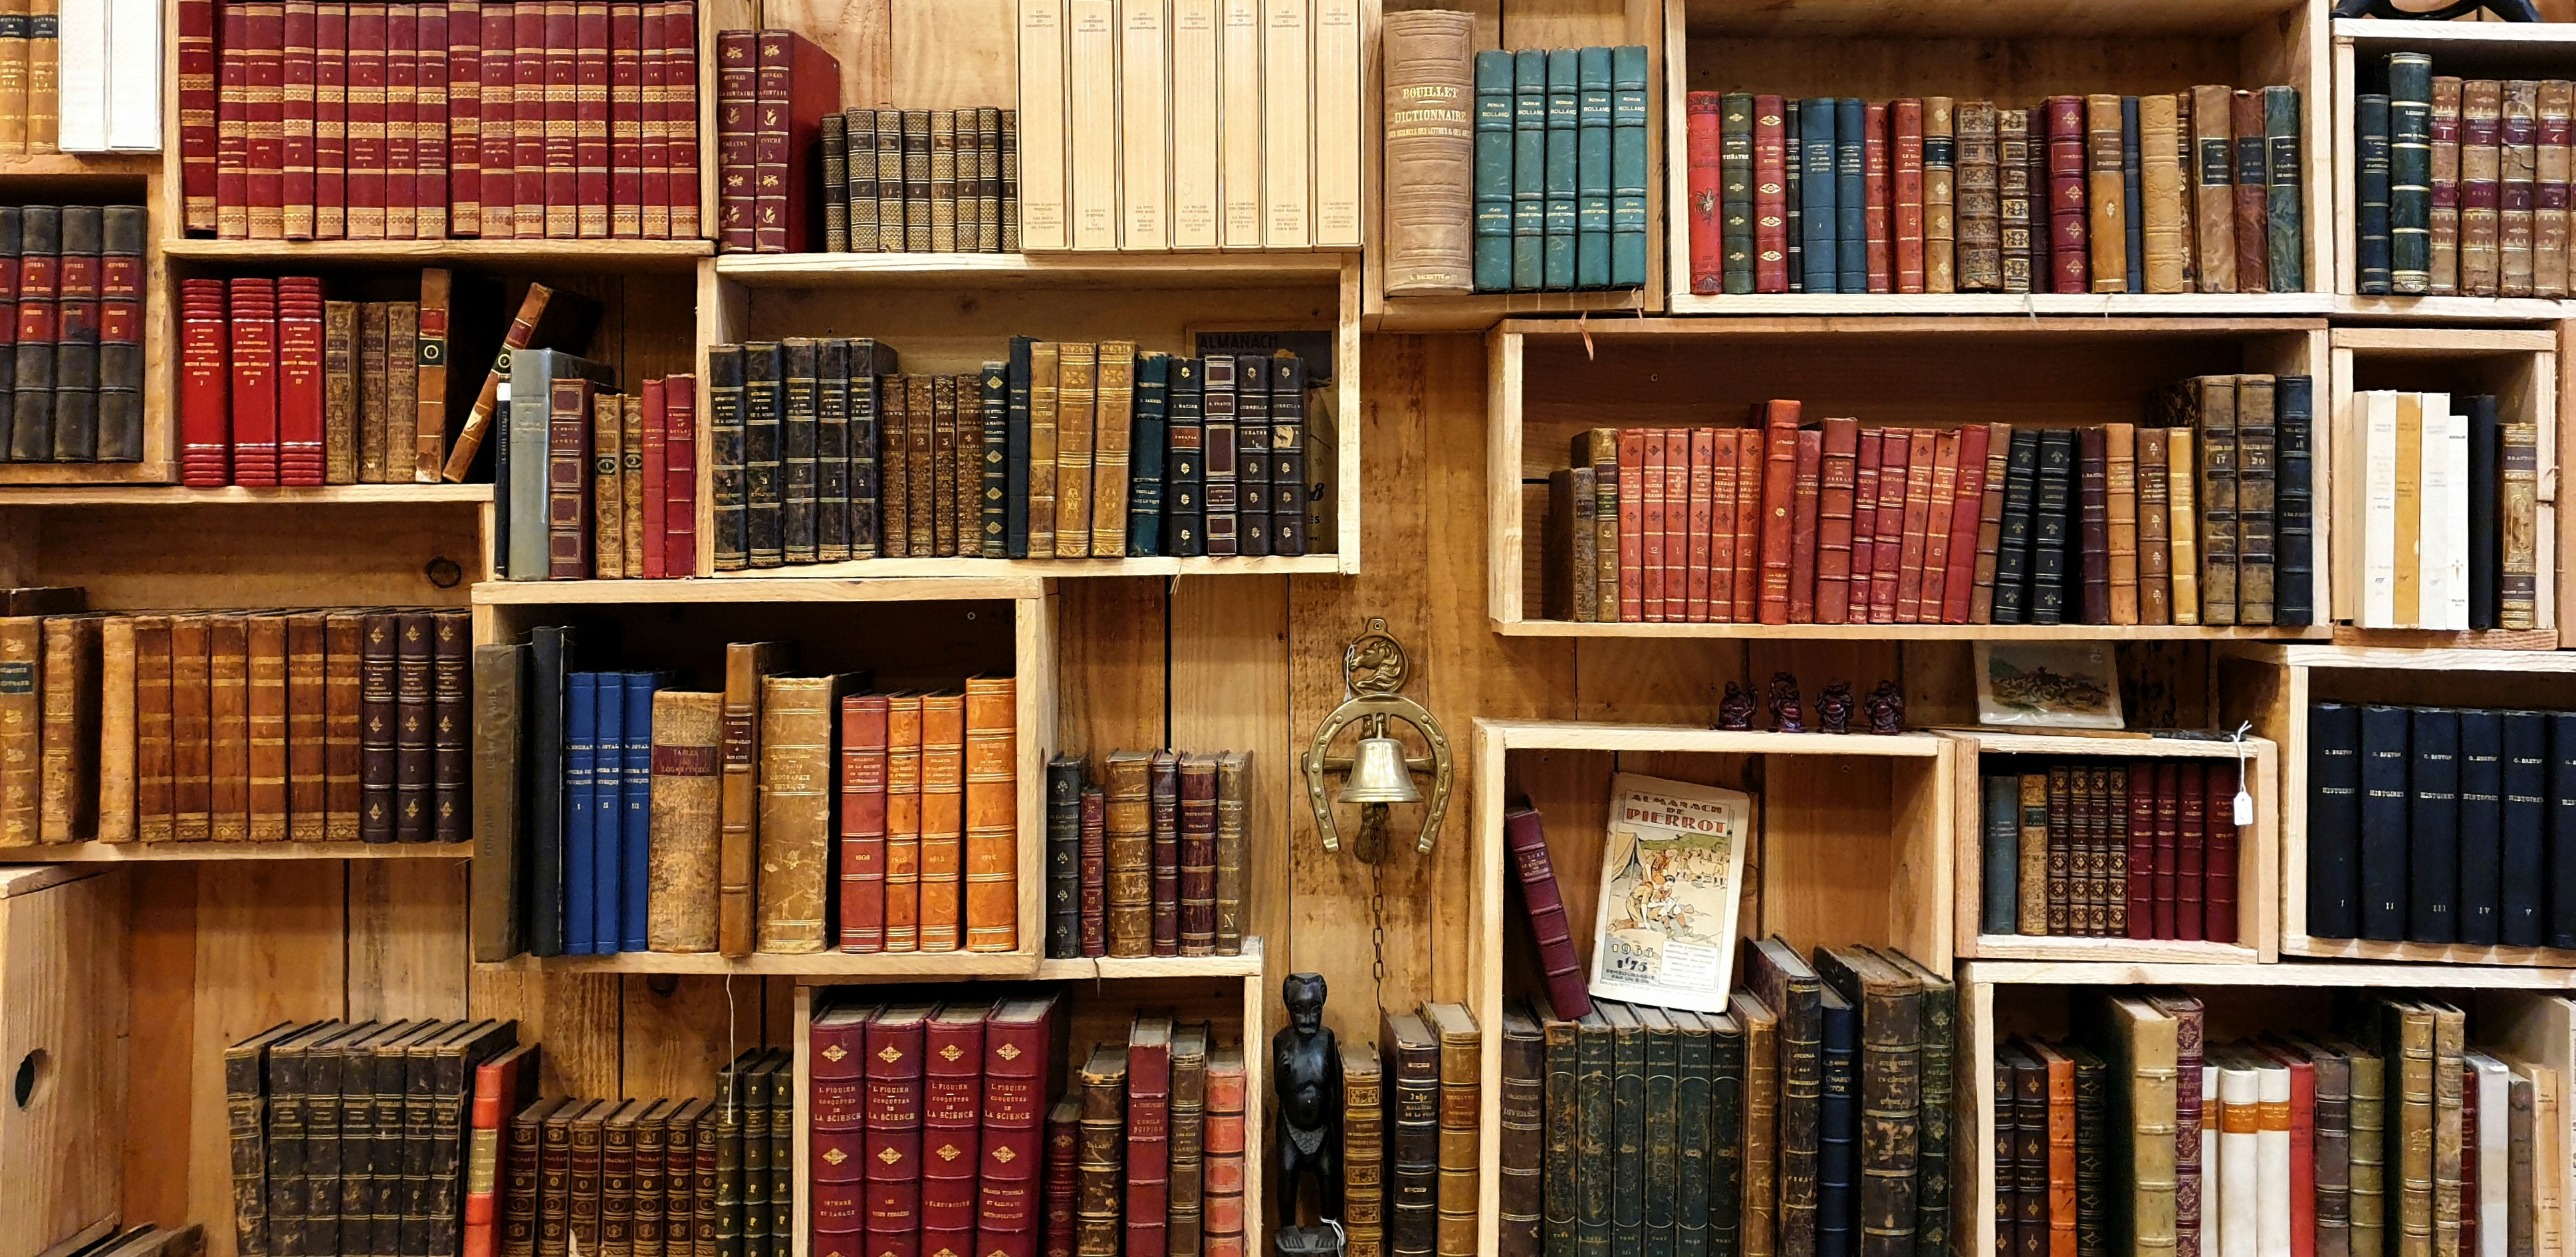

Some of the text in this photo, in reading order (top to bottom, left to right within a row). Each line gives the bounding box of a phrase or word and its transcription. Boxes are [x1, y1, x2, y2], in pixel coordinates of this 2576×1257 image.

[1402, 86, 1459, 99] BOUILLET
[1395, 109, 1466, 123] DICTIONNAIRE
[2442, 130, 2447, 138] 1
[2551, 134, 2559, 142] 4
[731, 151, 738, 160] 4
[767, 150, 773, 160] 5
[2517, 197, 2521, 205] 1
[1631, 794, 1722, 814] ALMANACH
[1667, 807, 1685, 816] DE
[1626, 808, 1726, 834] PIERROT
[1224, 914, 1234, 927] N
[827, 1113, 862, 1122] SCIENCE
